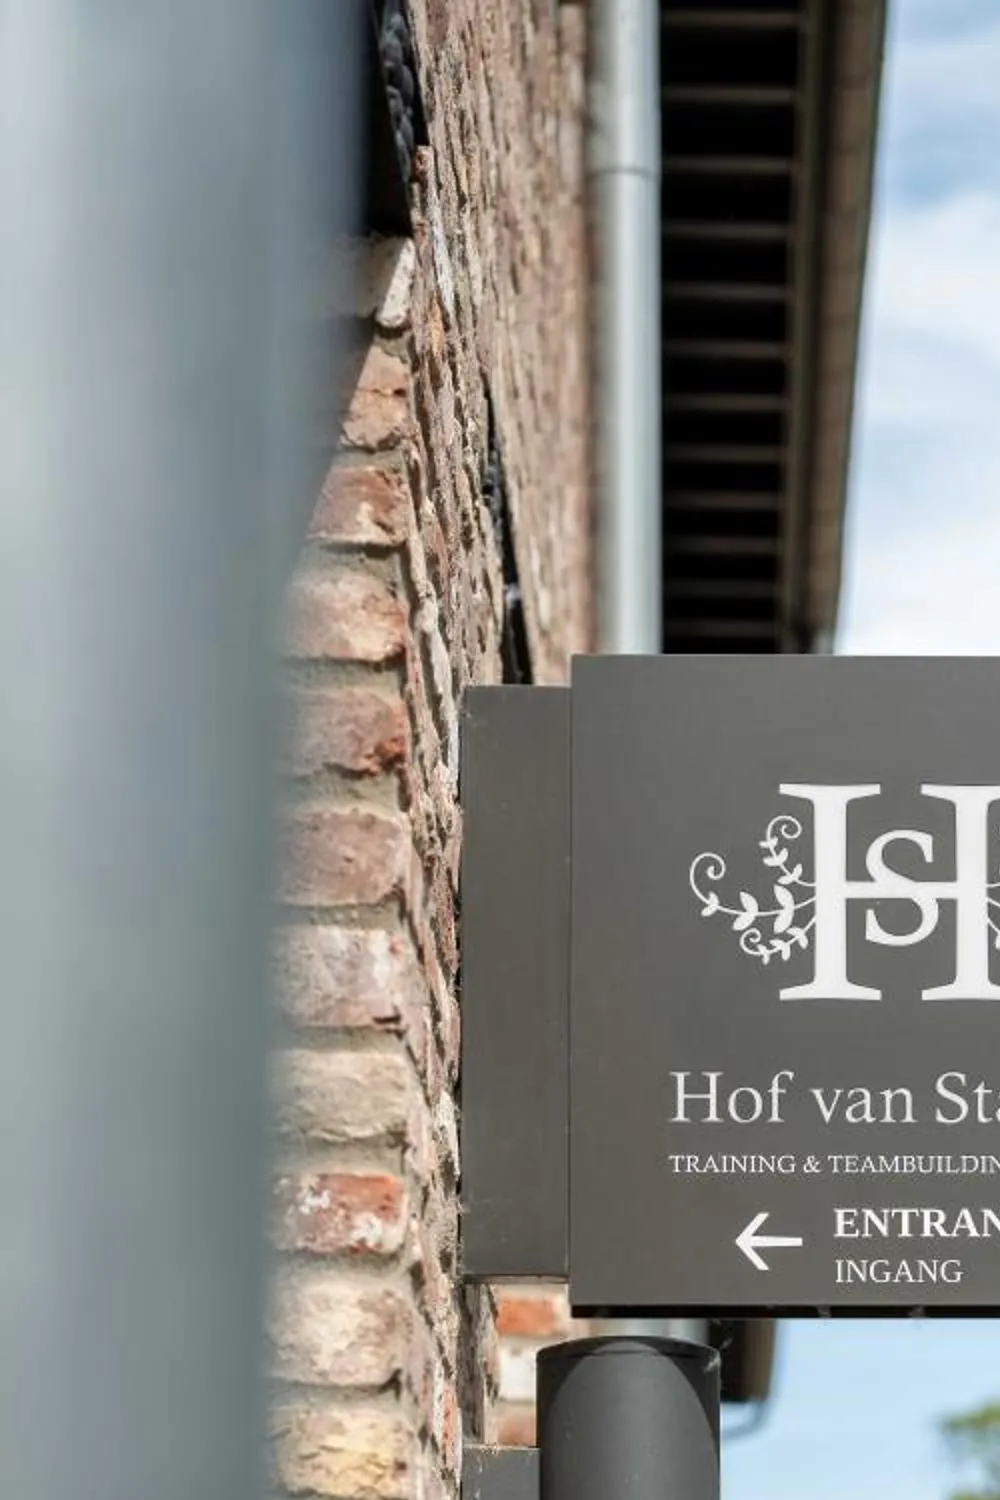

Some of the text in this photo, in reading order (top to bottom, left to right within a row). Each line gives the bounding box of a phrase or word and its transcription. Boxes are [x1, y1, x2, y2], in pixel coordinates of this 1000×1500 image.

[669, 1069, 795, 1124] Hof
[809, 1087, 918, 1124] van
[667, 1154, 797, 1174] TRAINING
[801, 1154, 822, 1174] &
[835, 1258, 964, 1284] INGANG
